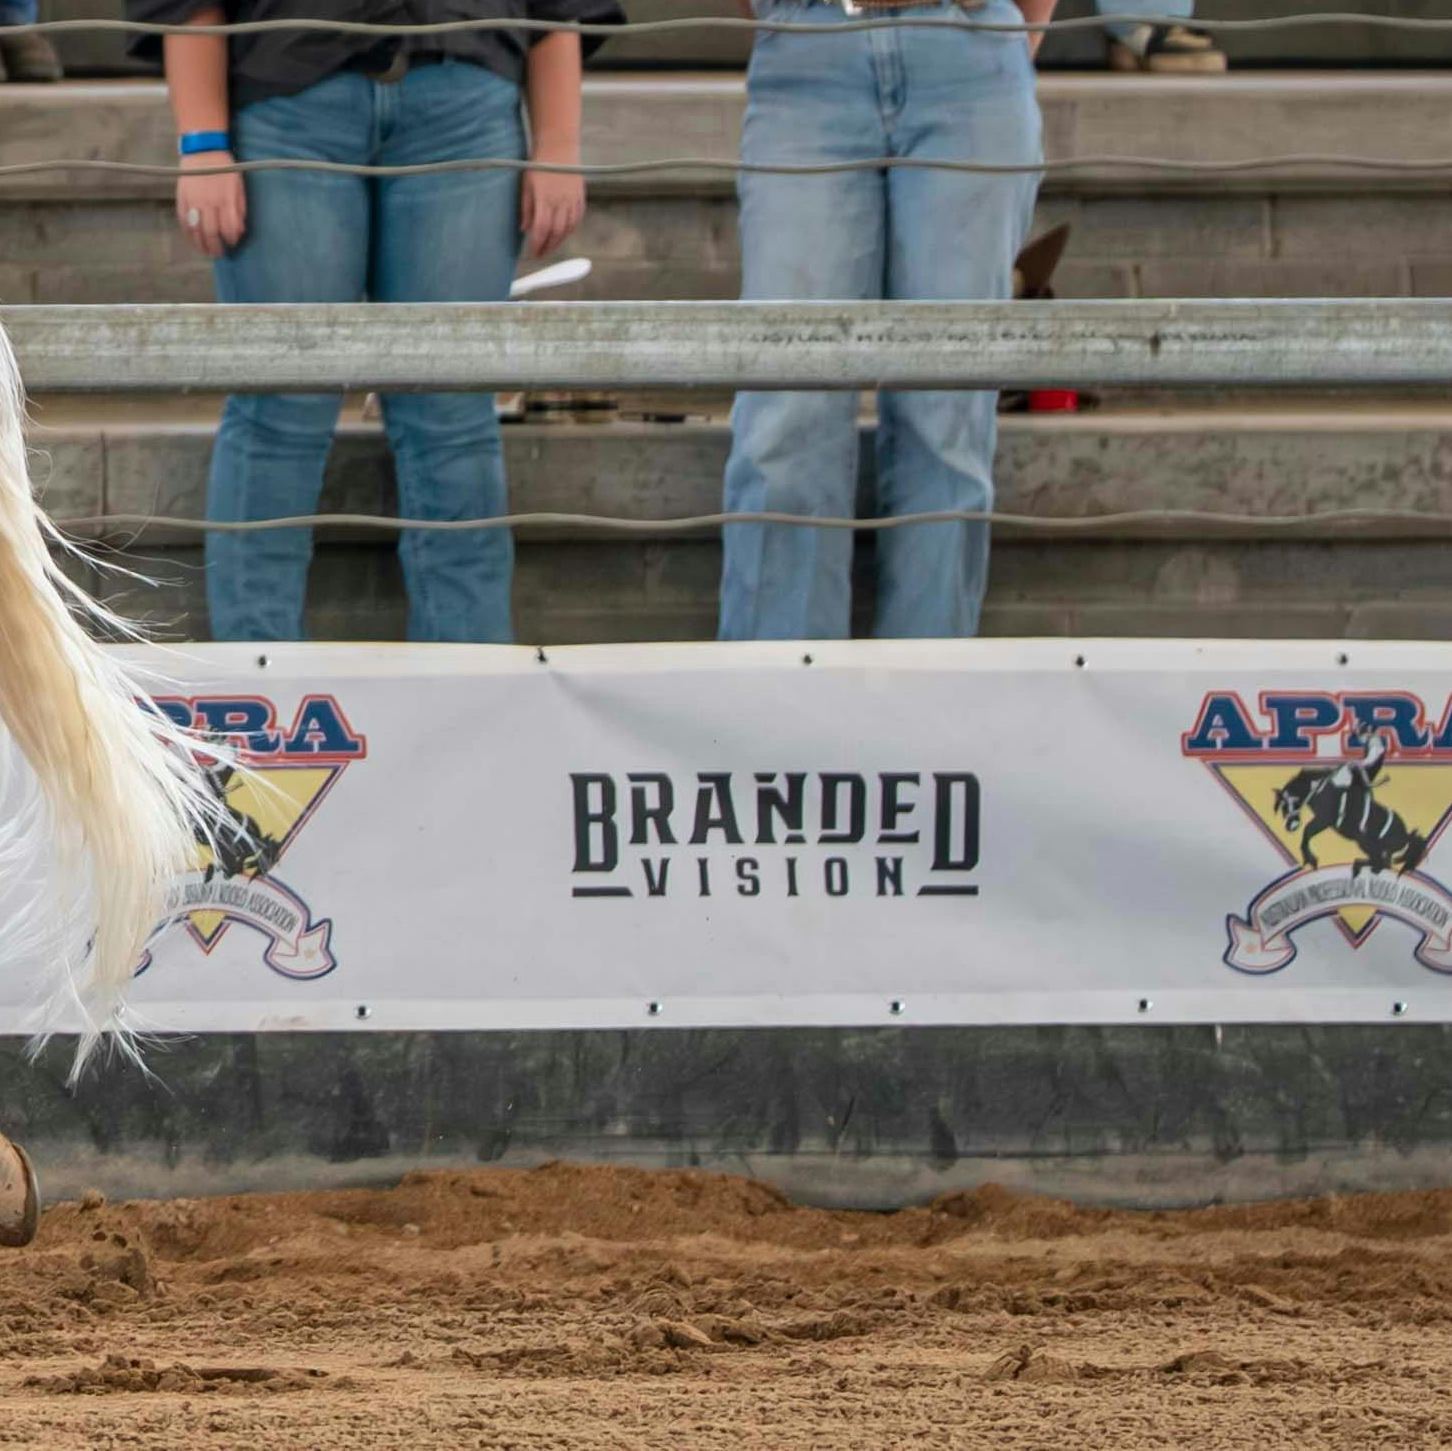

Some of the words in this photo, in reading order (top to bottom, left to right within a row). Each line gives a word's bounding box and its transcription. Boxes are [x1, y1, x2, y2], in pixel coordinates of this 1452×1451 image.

[133, 694, 368, 760] RA
[569, 771, 982, 873] BRANDED
[641, 856, 905, 897] VISION
